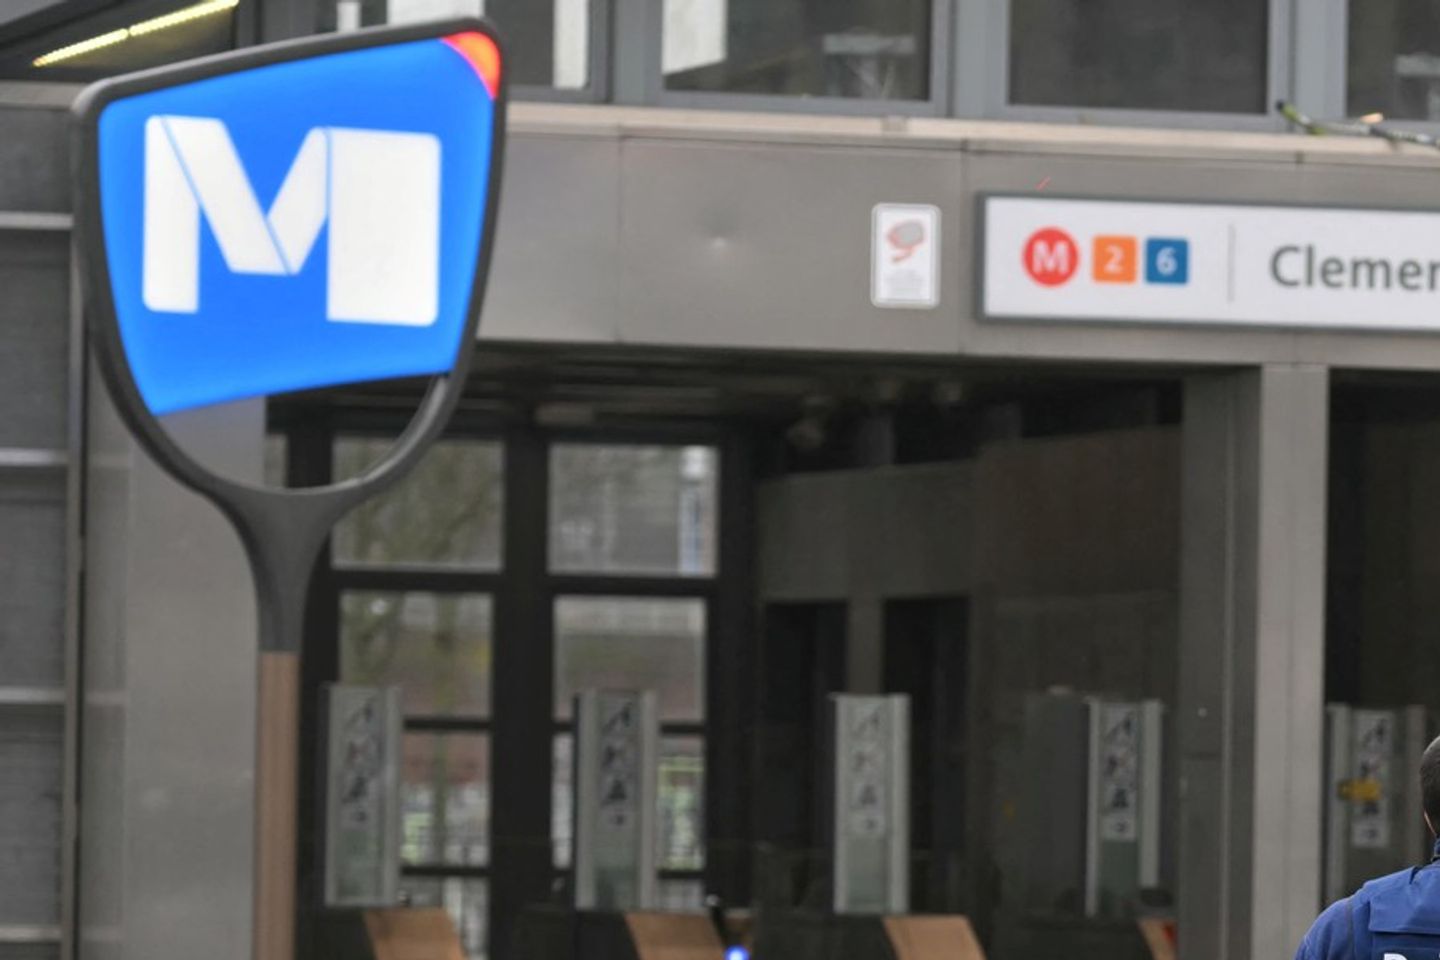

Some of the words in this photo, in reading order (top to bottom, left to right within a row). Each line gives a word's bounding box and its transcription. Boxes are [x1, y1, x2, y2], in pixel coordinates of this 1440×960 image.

[143, 115, 442, 327] M
[1032, 240, 1070, 275] M
[1103, 244, 1124, 275] 2
[1155, 245, 1178, 276] 6
